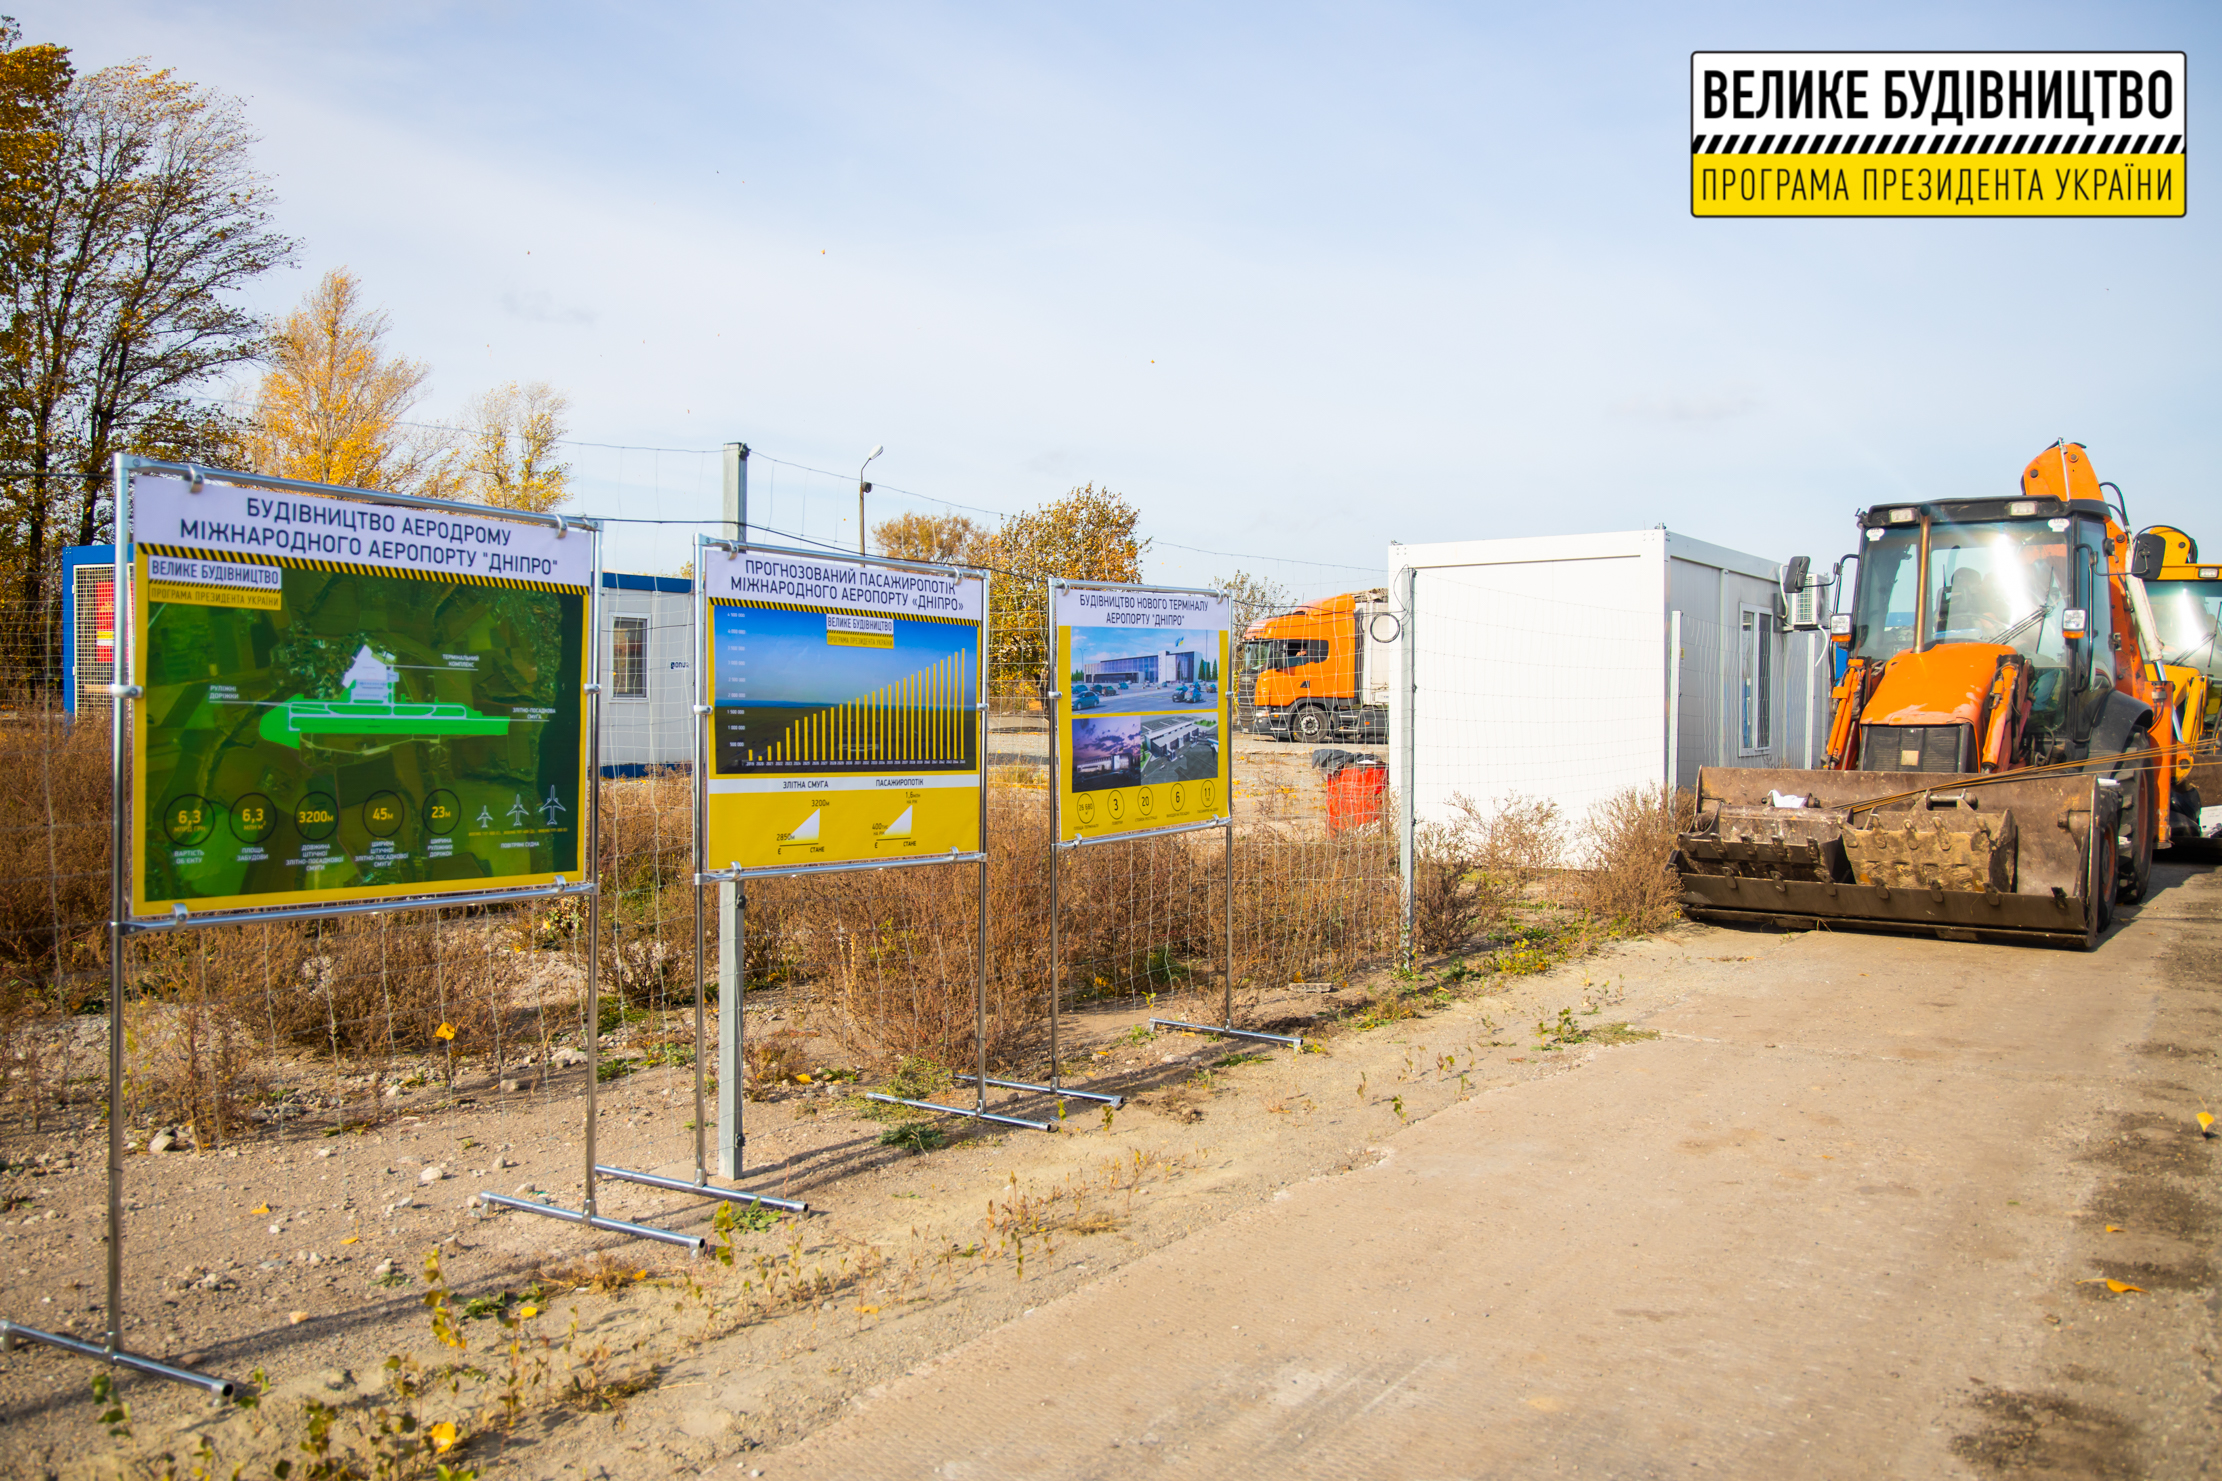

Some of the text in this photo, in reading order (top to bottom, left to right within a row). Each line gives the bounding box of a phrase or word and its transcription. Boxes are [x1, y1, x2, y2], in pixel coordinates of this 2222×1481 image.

[247, 497, 511, 546] БУДІВНИЦТВО АЕРОДРОМУ
[180, 518, 558, 576] МІЖНАРОДНОГО АЕРОПОРТУ "ДНІПРО"
[151, 559, 279, 585] ВЕЛИКЕ БУДІВНИЦТВО
[745, 559, 956, 595] ПРОГНОЗОВАНИЙ ПАСАЖИРОПОТІК
[151, 587, 279, 607] ПРОГРАМА ПРЕЗИДЕНТА УКРАЇНИ
[730, 576, 964, 612] МІЖНАРОДНОГО АЕРОПОРТУ «ДНІПРО»
[1079, 594, 1209, 612] БУДІВНИЦТВО НОВОГО ТЕРМІНАЛУ
[827, 616, 893, 632] ВЕЛИКЕ БУДІВНИЦТВО
[1106, 612, 1185, 627] АЕРОПОРТУ "ДНІПРО"
[827, 635, 893, 648] ПРОГРАМА ПРЕЗИДЕНТА УКРАЇНИ
[442, 653, 480, 662] ТЕРМІНАЛЬНИЙ
[209, 692, 239, 700] ДОРІЖКИ
[782, 780, 829, 790] ЗЛІТНА СМУГА
[875, 778, 924, 788] ПАСАЖИРОПОТІК
[1175, 791, 1180, 803] 6
[1204, 787, 1211, 798] 11
[1113, 798, 1119, 811] 3
[1141, 796, 1150, 807] 20
[178, 809, 201, 825] 6,3
[242, 808, 264, 824] 6,3
[371, 840, 395, 848] ШИРИНА
[430, 837, 453, 845] ШИРИНА
[874, 840, 917, 849] Є СТАНЕ
[174, 849, 205, 857] ВАРТІСТЬ
[301, 843, 331, 852] ДОВЖИНА
[777, 846, 825, 855] Є СТАНЕ
[236, 854, 269, 862] ЗАБУДОВИ
[302, 850, 328, 858] ШТУЧНОЇ
[354, 852, 409, 862] ЗЛІТНО-ПОСАДКОВОЇ
[428, 850, 453, 858] ДОРІЖОК
[285, 856, 344, 866] ЗЛІТНО-ПОСАДКОВОЇ
